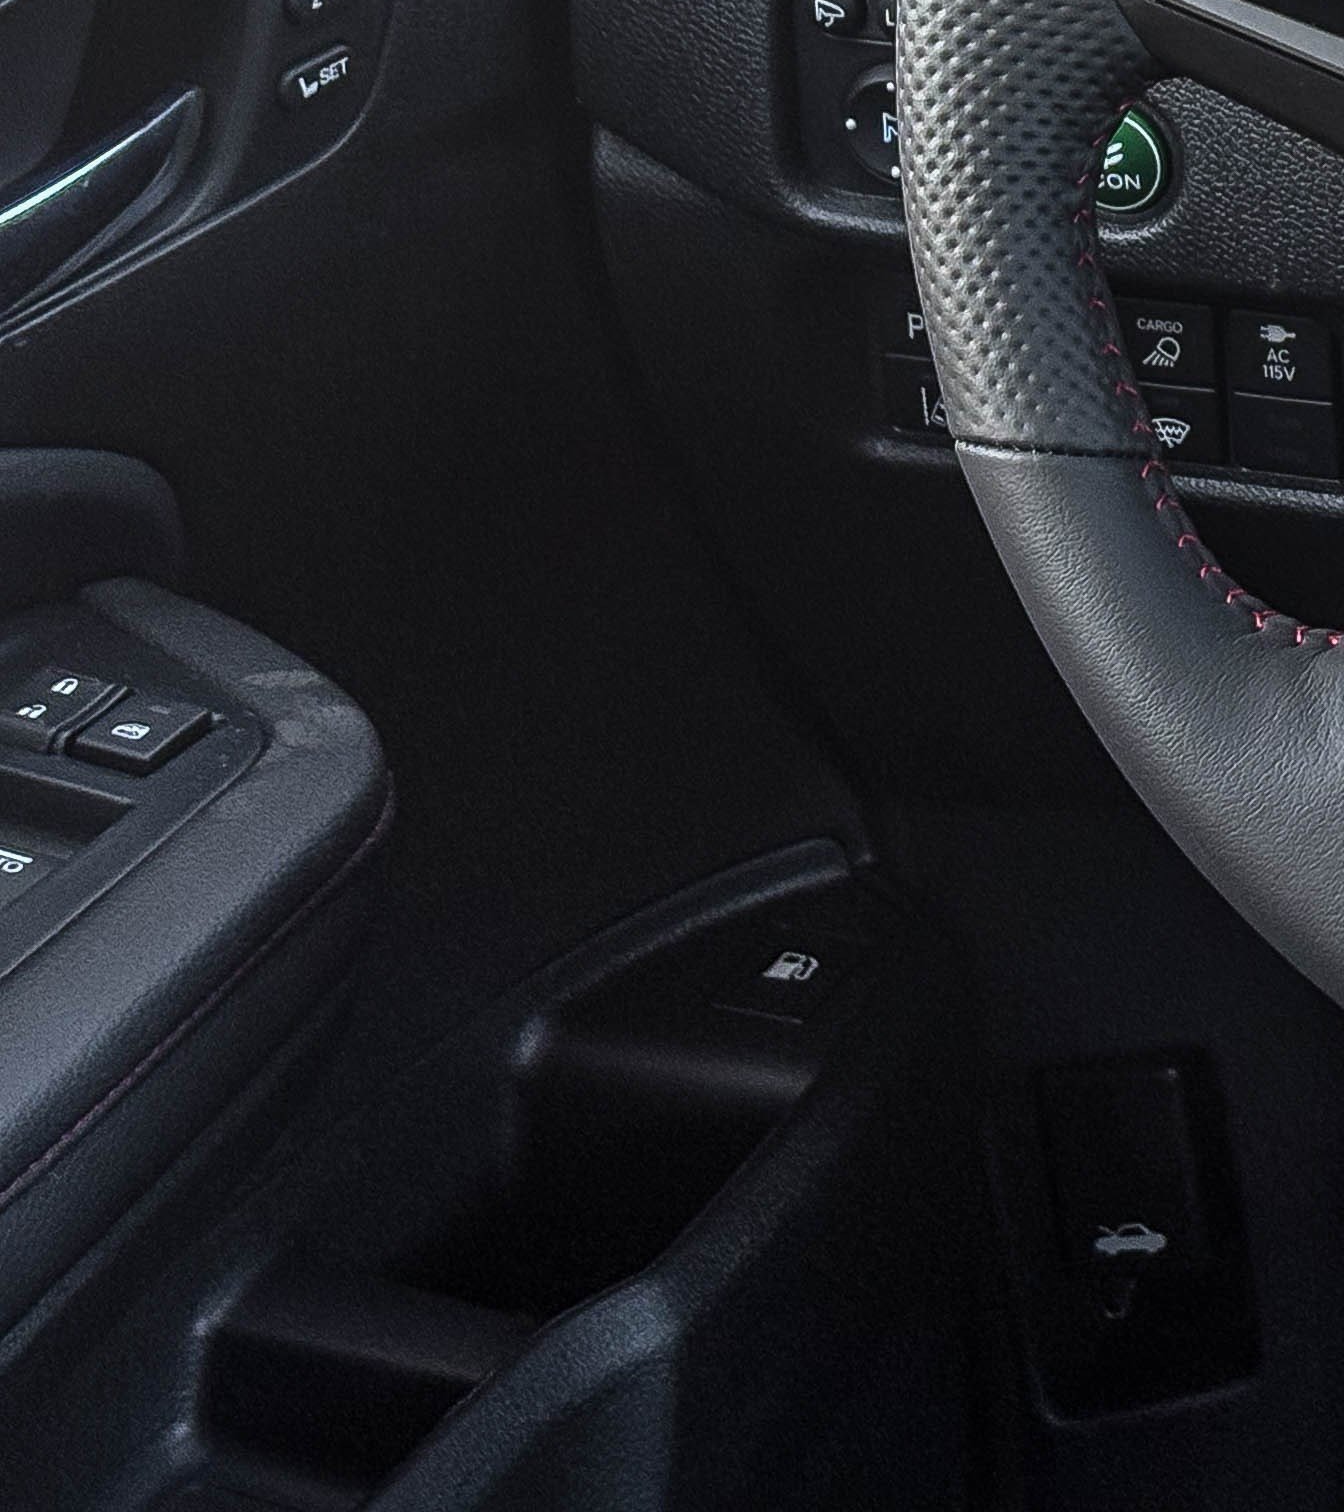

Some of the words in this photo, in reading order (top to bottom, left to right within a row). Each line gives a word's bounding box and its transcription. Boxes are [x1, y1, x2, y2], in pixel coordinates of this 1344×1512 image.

[318, 56, 349, 86] SET
[1136, 316, 1184, 335] CARGO
[1266, 347, 1290, 365] AC
[1262, 363, 1296, 382] 115V
